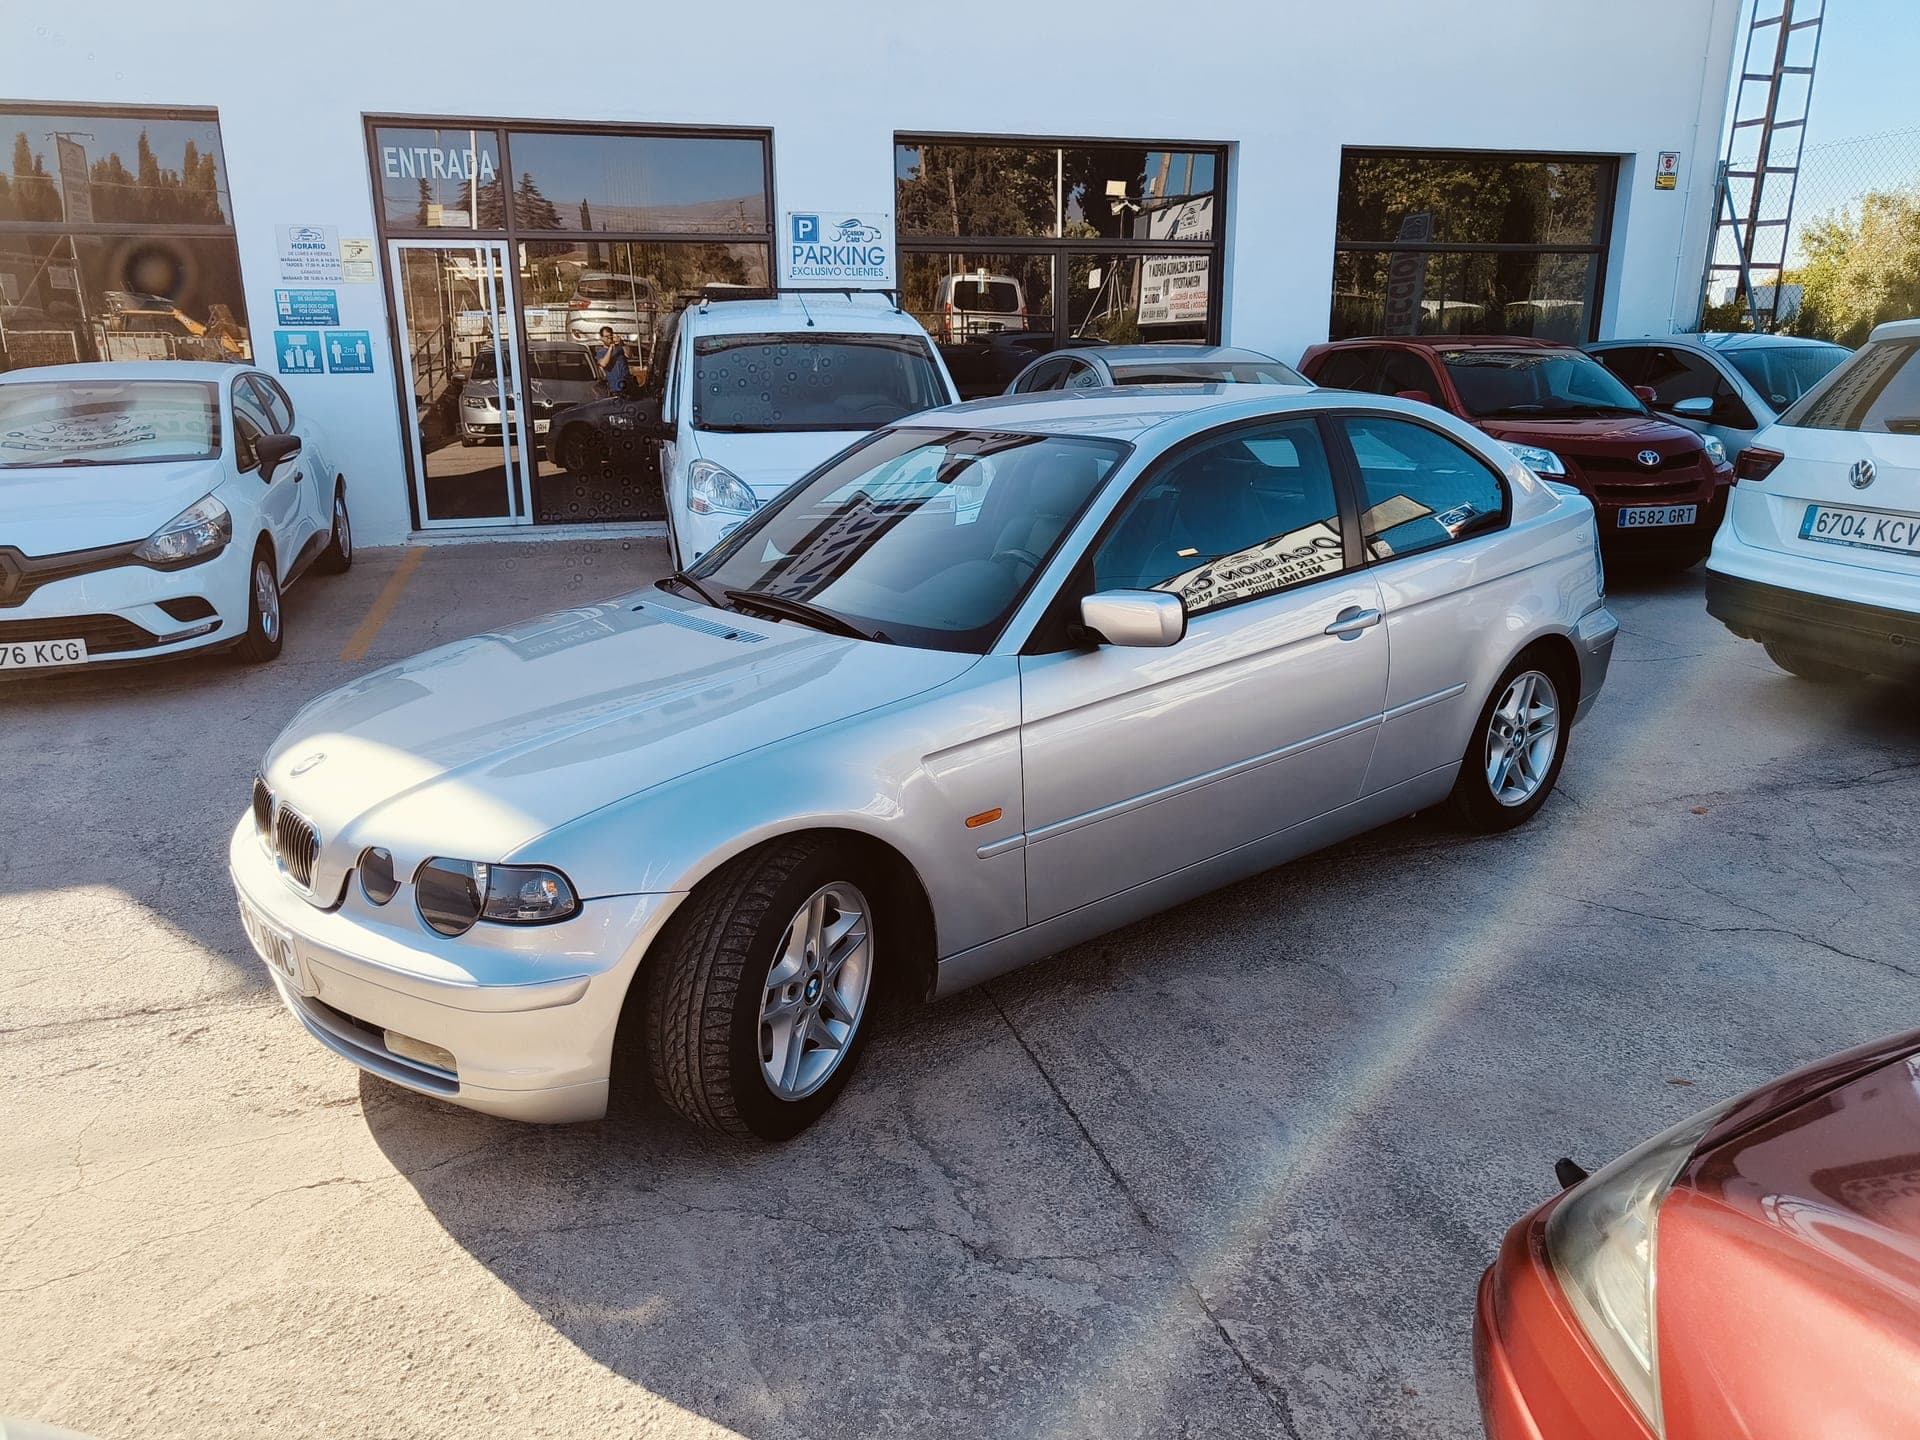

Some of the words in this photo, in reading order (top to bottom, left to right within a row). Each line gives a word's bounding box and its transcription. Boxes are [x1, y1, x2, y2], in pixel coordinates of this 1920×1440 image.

[383, 147, 496, 180] ENTRADA
[798, 220, 813, 239] P
[792, 246, 886, 266] PARKING
[792, 267, 842, 276] EXCLUSIVO
[844, 267, 884, 277] CLIENTES
[1628, 510, 1665, 526] 6582
[1668, 507, 1694, 524] GRT
[1816, 512, 1867, 538] 6704
[0, 646, 26, 665] 76
[34, 643, 79, 663] KCG
